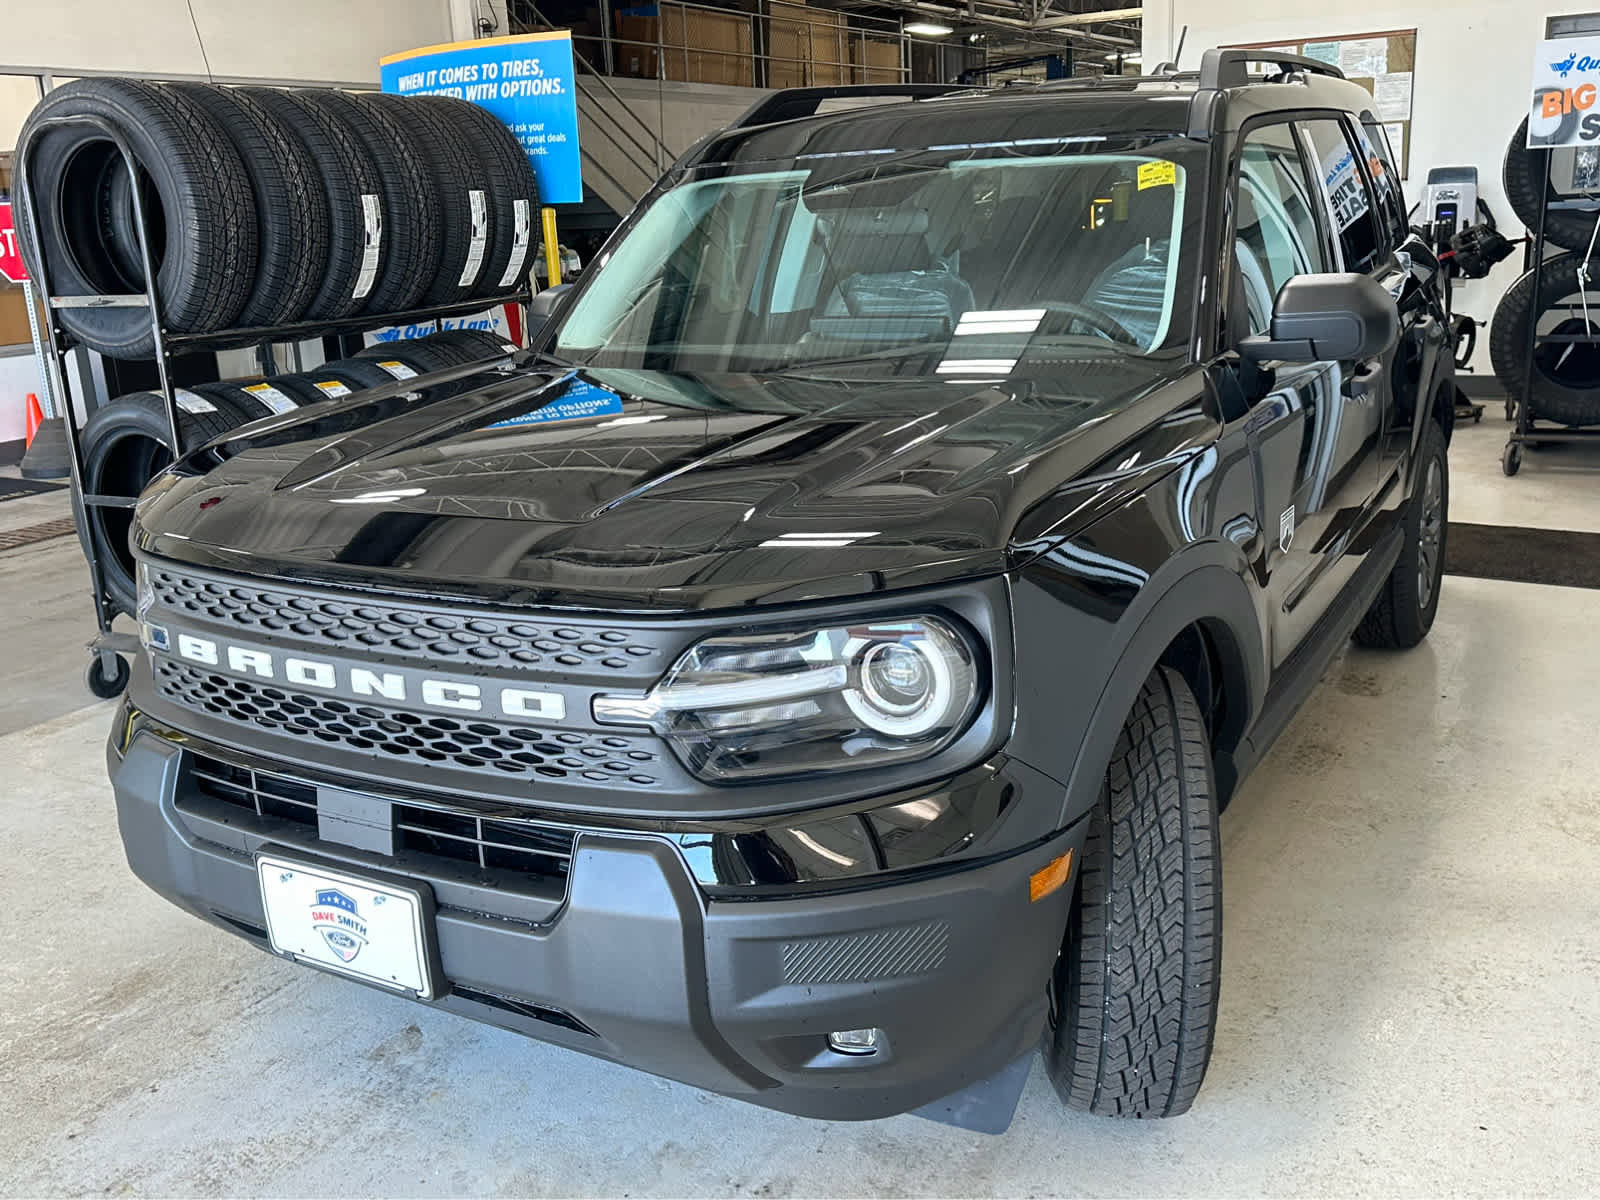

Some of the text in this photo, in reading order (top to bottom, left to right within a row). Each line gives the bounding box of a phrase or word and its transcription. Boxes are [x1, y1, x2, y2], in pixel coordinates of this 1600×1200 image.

[398, 58, 545, 92] WHEN IT COMES TO TIRES,
[465, 83, 498, 101] WITH
[500, 77, 566, 98] OPTIONS.
[1542, 83, 1597, 120] BIG
[515, 122, 527, 132] ask
[528, 122, 545, 134] your
[527, 133, 547, 145] great
[547, 132, 567, 143] deals
[404, 318, 499, 339] Quik Lane
[178, 633, 567, 720] BRONCO
[312, 911, 367, 936] DAVE SMITH
